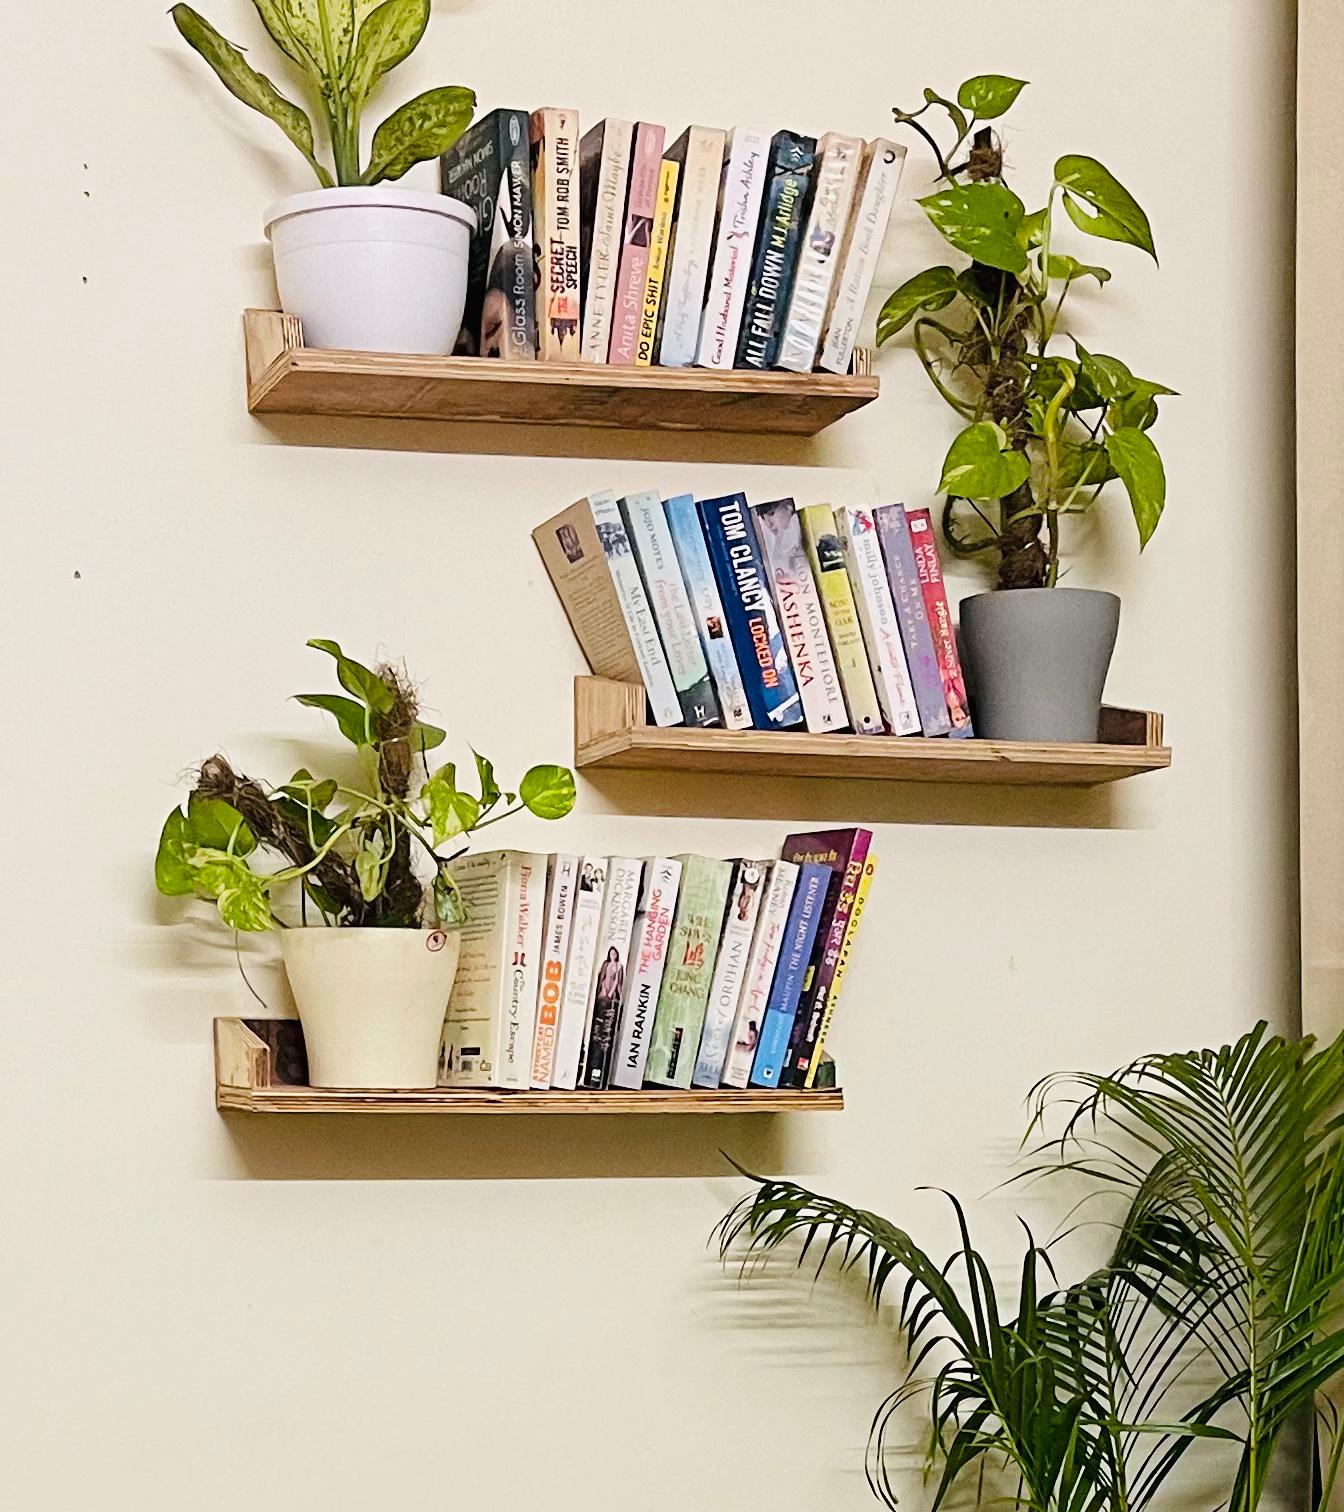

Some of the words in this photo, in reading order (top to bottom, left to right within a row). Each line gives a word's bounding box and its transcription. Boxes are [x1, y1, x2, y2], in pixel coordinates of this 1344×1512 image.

[555, 137, 569, 174] SMITH
[510, 160, 523, 206] MAWER
[556, 179, 570, 202] ROB
[734, 192, 749, 228] Trisha
[742, 151, 759, 190] Ashley
[775, 178, 798, 224] Arlidge
[512, 209, 524, 248] SIMON
[556, 206, 570, 230] TOM
[512, 254, 525, 295] Room
[550, 238, 565, 293] SECRET
[565, 246, 577, 289] SPEECH
[594, 251, 609, 301] TYLER
[622, 256, 644, 309] Shreve
[759, 250, 784, 299] DOWN
[646, 277, 659, 306] SHIT
[511, 298, 526, 346] Glass
[590, 305, 603, 351] ANNE
[617, 315, 637, 359] Anita
[641, 309, 655, 338] EPIC
[751, 303, 775, 337] FALL
[638, 341, 650, 361] DO
[745, 340, 767, 367] ALL
[640, 507, 655, 533] JOJO
[649, 534, 665, 570] MOYES
[718, 501, 746, 541] TOM
[862, 538, 878, 571] milly
[915, 546, 929, 584] LINDA
[925, 543, 940, 583] FINLAY
[731, 544, 766, 612] CLANCY
[868, 573, 890, 625] johnson
[775, 568, 815, 687] SASHENKA
[748, 617, 773, 666] LOCKED
[762, 667, 778, 688] ON
[806, 602, 838, 705] MONTEFIORE
[519, 864, 533, 901] Fiona
[557, 885, 568, 920] BOWEN
[607, 868, 625, 940] DICKINSON
[801, 875, 820, 919] LISTENER
[517, 902, 531, 948] Walker
[618, 870, 636, 942] MARGARET
[643, 888, 662, 947] HANGING
[553, 924, 563, 954] JAMES
[653, 907, 670, 962] GARDEN
[793, 919, 809, 952] NIGHT
[638, 951, 651, 974] THE
[719, 940, 742, 1007] ORPHAN
[789, 952, 801, 971] THE
[509, 969, 525, 1018] Country
[540, 959, 563, 1026] BOB
[631, 983, 651, 1039] RANKIN
[669, 982, 704, 999] CHANG
[780, 974, 795, 1011] MAUPIN
[507, 1021, 519, 1064] Escape
[539, 1026, 555, 1084] NAMED
[626, 1042, 640, 1068] IAN
